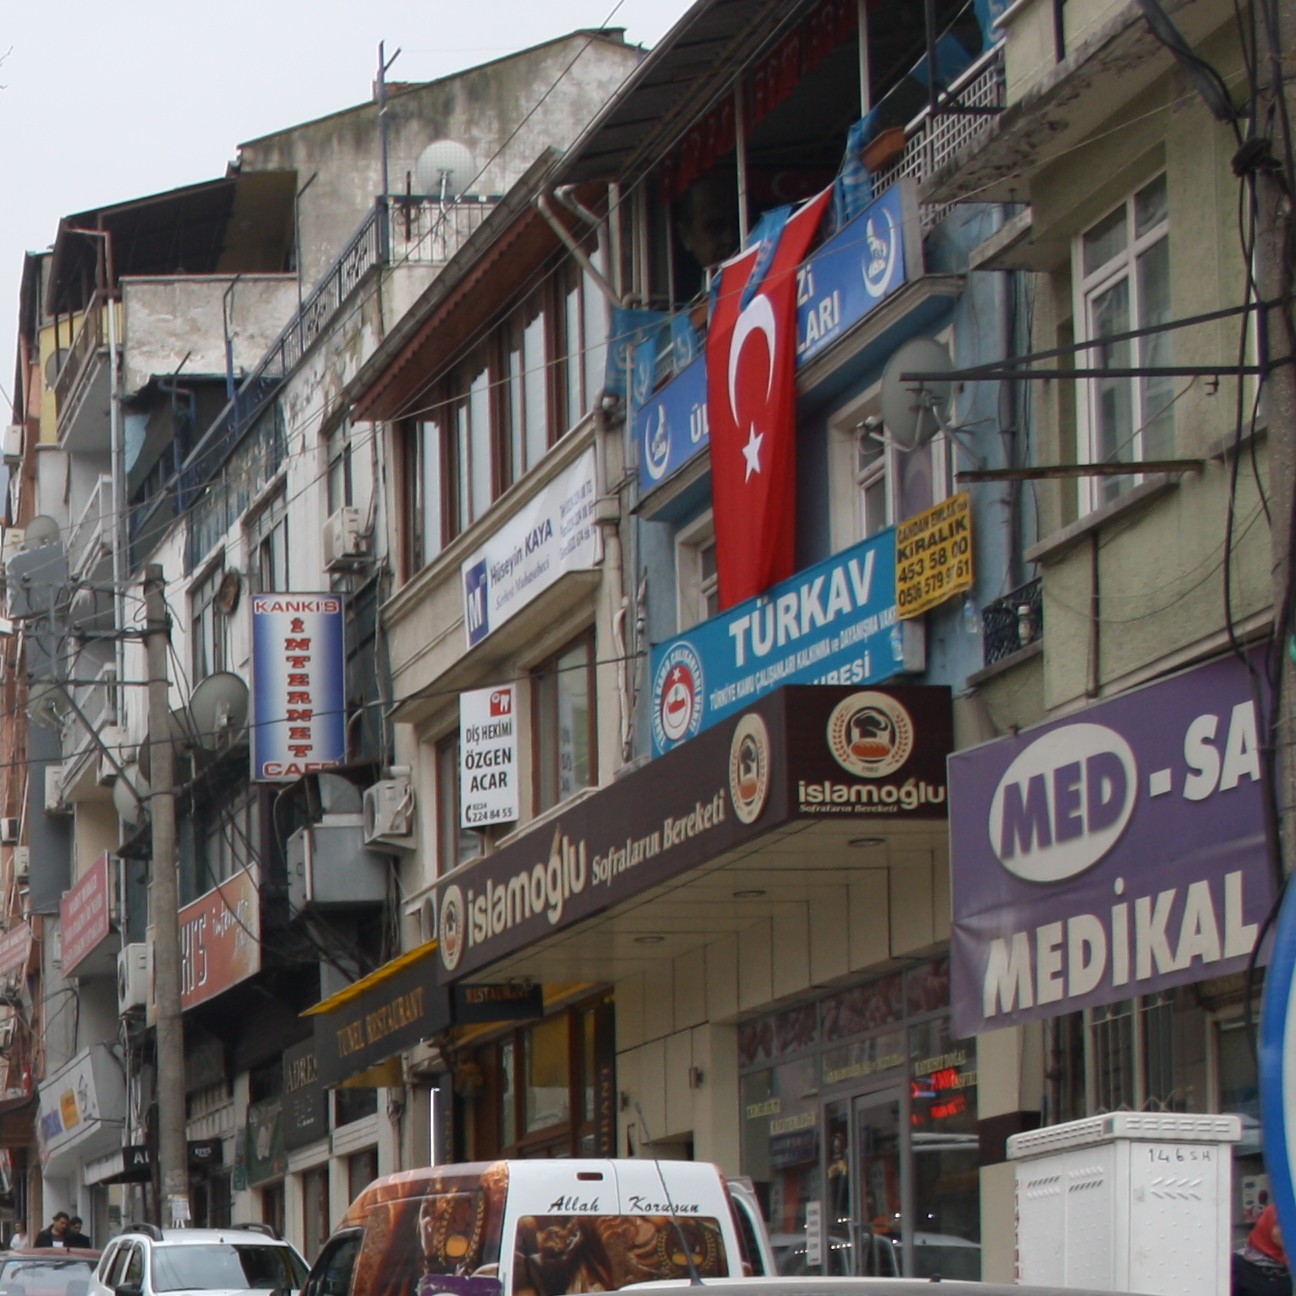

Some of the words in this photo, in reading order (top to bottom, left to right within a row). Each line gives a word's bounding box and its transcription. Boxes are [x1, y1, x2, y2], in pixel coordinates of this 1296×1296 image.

[490, 547, 523, 589] Hüseyin
[524, 518, 553, 557] KAYA
[896, 514, 967, 564] KİRALIK
[898, 558, 924, 584] 453
[929, 547, 947, 570] 58
[255, 601, 339, 613] KANKI'S
[728, 549, 877, 668] TÜRKAV
[808, 650, 871, 685] UBESİ
[466, 724, 480, 746] DİŞ
[481, 718, 512, 741] HEKİMİ
[465, 748, 512, 770] ÖZGEN
[470, 771, 508, 793] ACAR
[472, 811, 488, 823] 224
[662, 788, 726, 851] Bereketi
[983, 870, 1259, 1019] MEDİKAL
[547, 1195, 600, 1213] Allah
[627, 1195, 699, 1213] Korusun
